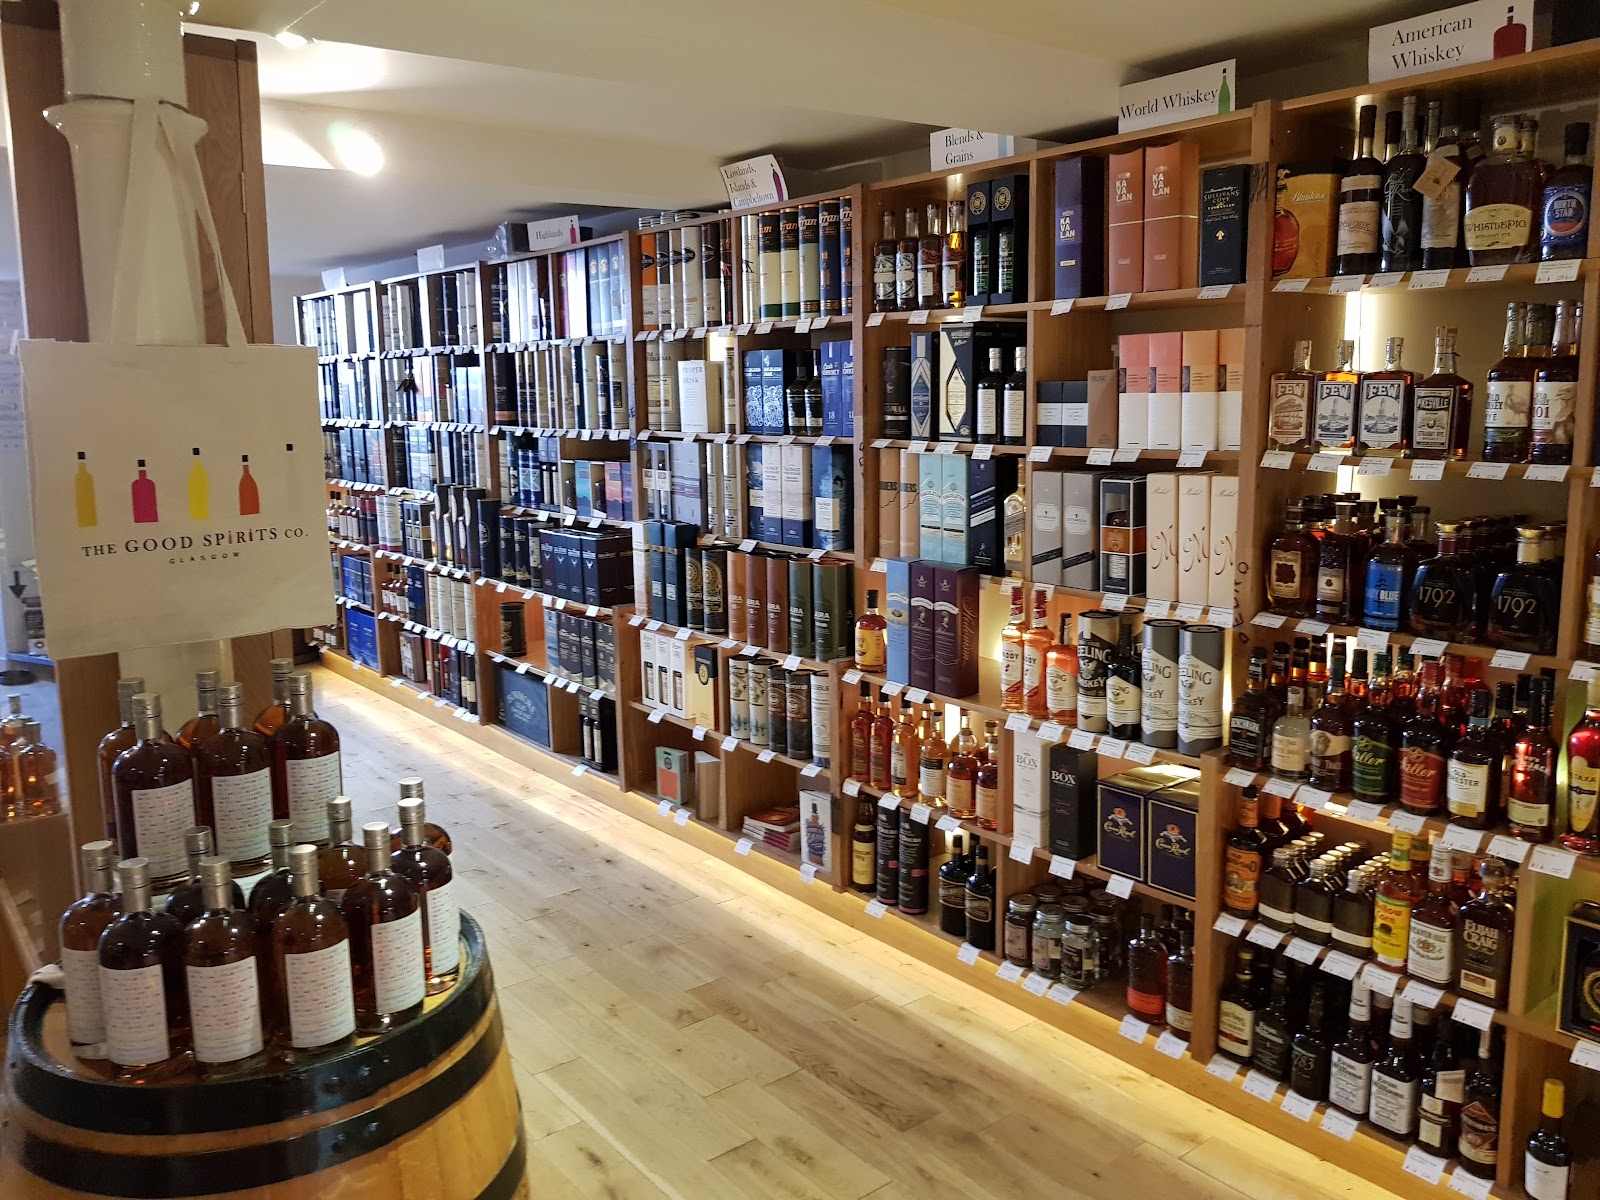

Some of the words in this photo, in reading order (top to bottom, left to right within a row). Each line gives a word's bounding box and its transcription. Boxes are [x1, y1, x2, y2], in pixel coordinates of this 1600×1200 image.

[1392, 15, 1473, 47] American
[1392, 42, 1465, 71] Whiskey
[1119, 98, 1159, 120] World
[1163, 87, 1219, 111] Whiskey
[945, 131, 974, 148] Blends
[945, 150, 974, 165] Grains
[724, 164, 757, 179] Lowlands,
[1116, 180, 1127, 188] KA
[1116, 187, 1127, 195] VA
[1116, 193, 1132, 203] LAN
[1152, 186, 1170, 197] LAN
[734, 192, 775, 207] Campbeltown
[1060, 216, 1070, 224] KA
[535, 228, 564, 241] Highlands
[1060, 230, 1075, 239] LAN
[1277, 383, 1305, 397] FEW
[1323, 384, 1350, 398] FEW
[1369, 384, 1398, 398] FEW
[1487, 393, 1500, 401] ILD
[82, 543, 118, 557] THE
[125, 535, 193, 553] GOOD
[284, 526, 309, 539] CO.
[168, 551, 240, 565] GLASGOW
[1380, 590, 1400, 601] BLUE
[1419, 586, 1456, 608] 1792
[1497, 595, 1537, 619] 1792
[1002, 652, 1019, 660] ADDY
[1016, 754, 1038, 768] BOX
[1051, 770, 1076, 785] BOX
[1571, 772, 1596, 783] ETAXA
[1464, 919, 1499, 939] ELIJAH
[1463, 930, 1498, 950] CRAIG
